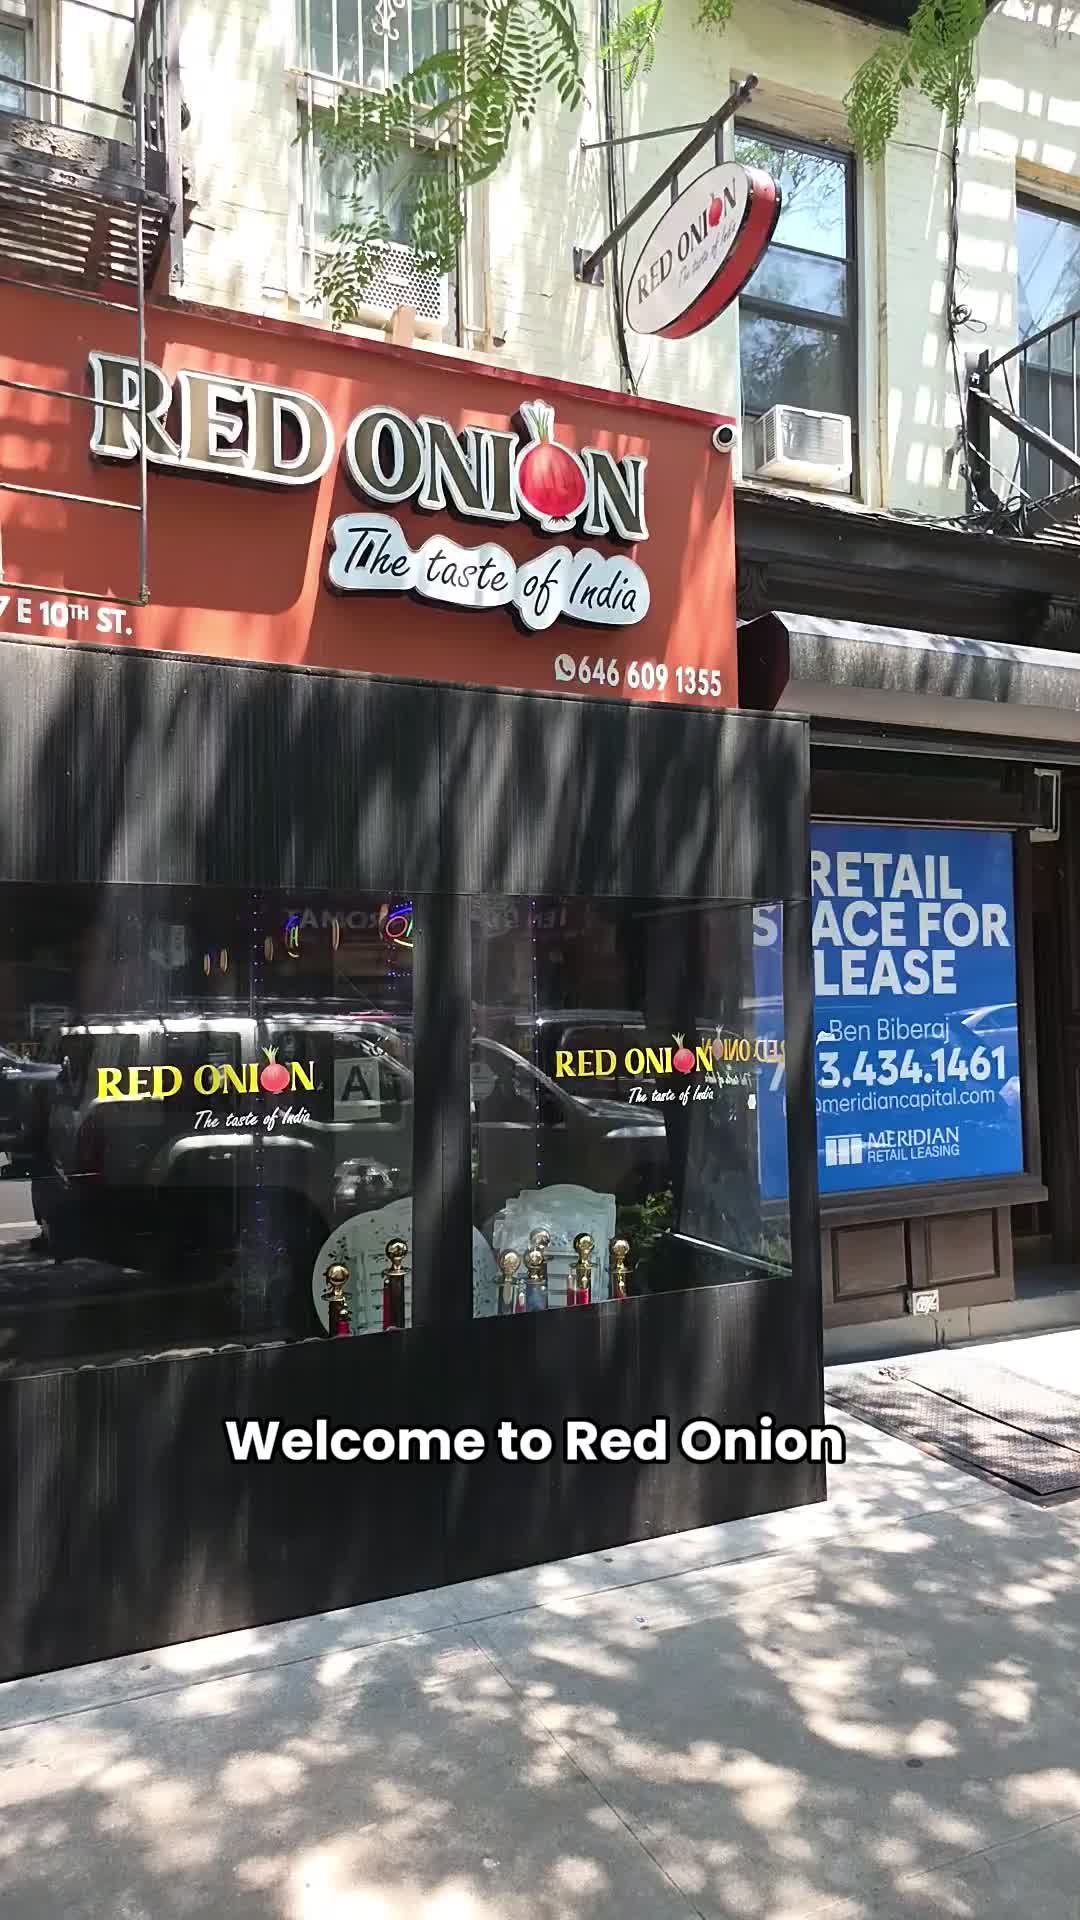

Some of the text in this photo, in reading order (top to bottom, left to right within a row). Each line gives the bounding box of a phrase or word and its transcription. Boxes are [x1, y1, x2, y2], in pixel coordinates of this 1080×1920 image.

[638, 250, 673, 304] RED
[89, 352, 334, 485] RED
[344, 527, 636, 615] The taste of India
[17, 598, 32, 624] E
[39, 601, 89, 628] 10TH
[96, 607, 133, 635] ST.
[578, 656, 722, 697] 646 609 1355
[810, 850, 962, 899] RETAIL
[918, 904, 1011, 947] FOR
[814, 950, 957, 996] LEASE
[829, 1017, 950, 1044] Ben Biberaj
[555, 1049, 617, 1078] RED
[97, 1065, 183, 1100] RED
[342, 1064, 371, 1101] A
[629, 1085, 714, 1106] The taste of India
[194, 1106, 311, 1131] The taste of India
[868, 1127, 960, 1148] MERIDIAN
[868, 1144, 960, 1164] RETAIL LEASING
